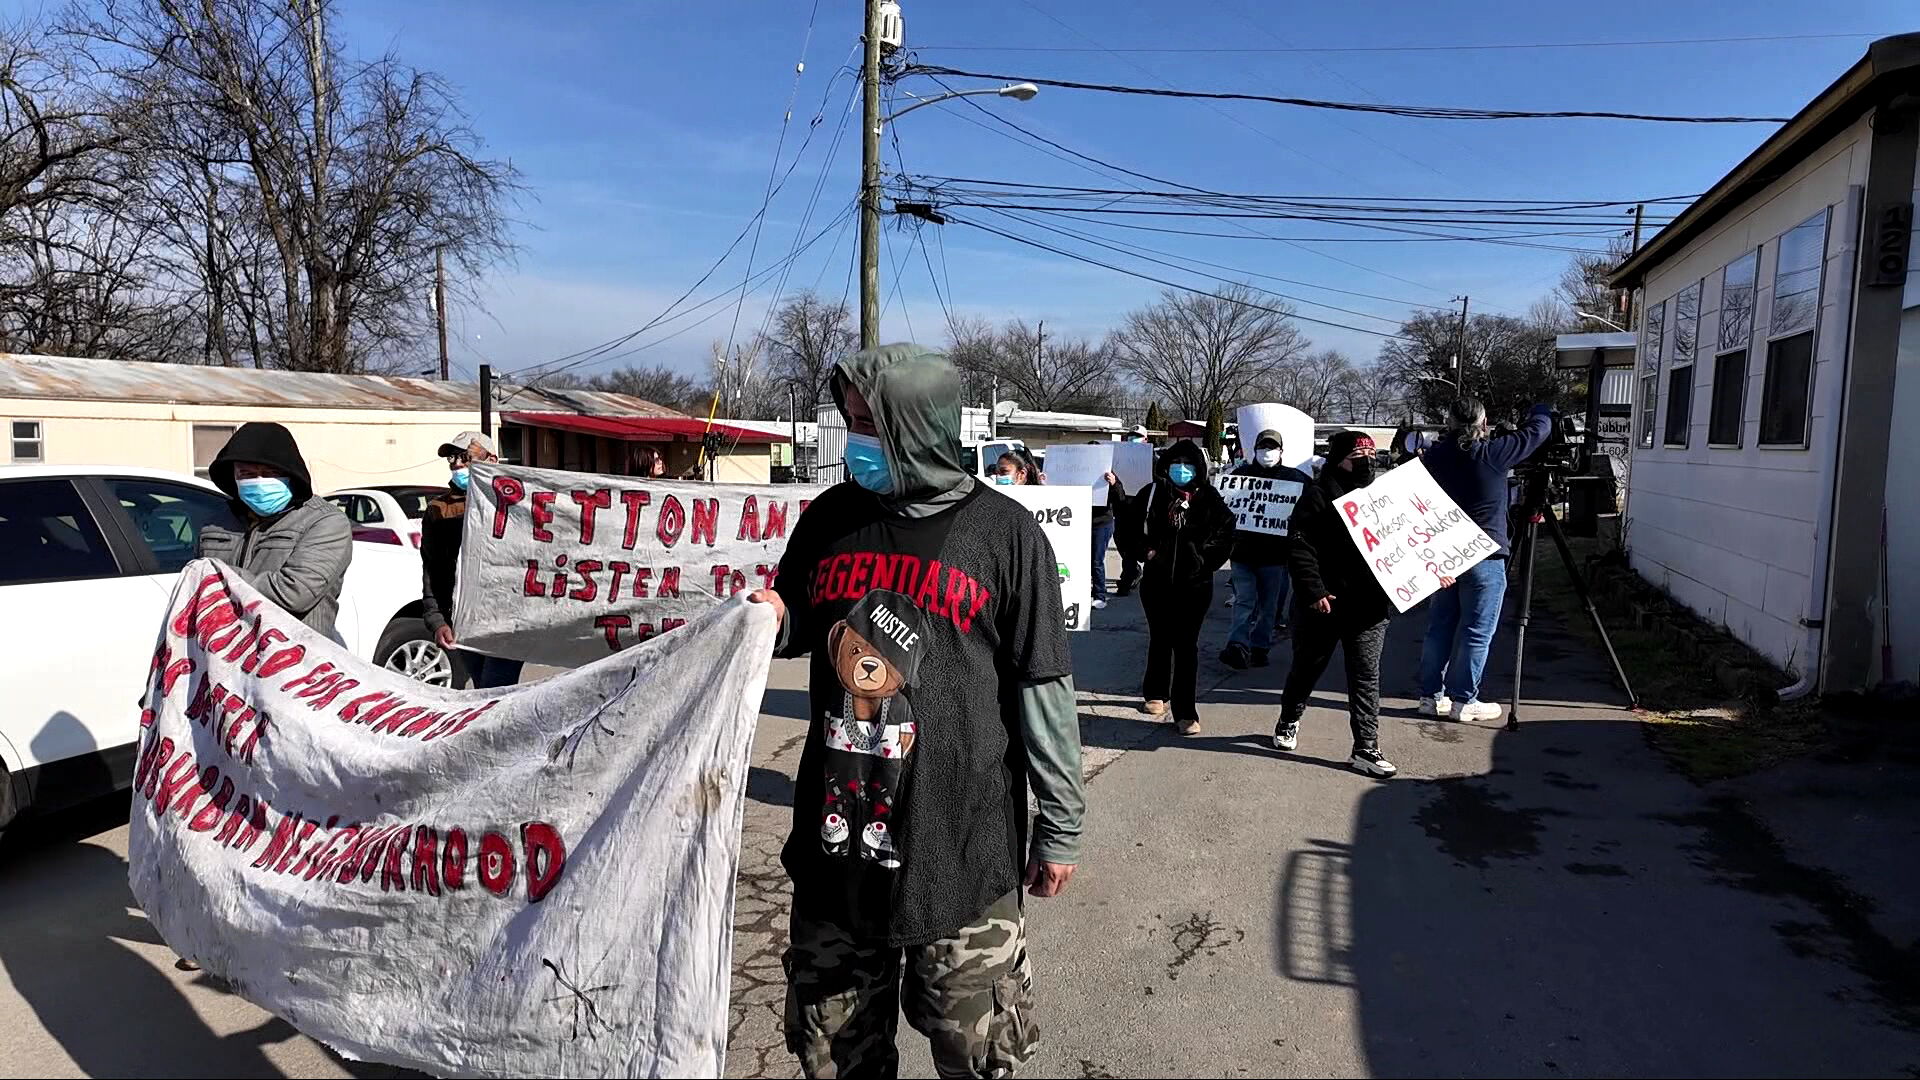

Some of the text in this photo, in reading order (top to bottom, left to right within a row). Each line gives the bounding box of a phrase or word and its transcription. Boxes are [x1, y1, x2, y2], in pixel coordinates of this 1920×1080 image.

[1220, 476, 1273, 491] PEYTON
[1249, 491, 1297, 505] ANDERSON
[1409, 493, 1438, 516] We
[492, 475, 812, 549] PEYTON AN
[1376, 543, 1406, 575] need
[1413, 507, 1471, 544] Solution
[1415, 547, 1435, 562] to
[1396, 534, 1493, 602] our Problems
[869, 603, 921, 652] HUSTLE
[279, 662, 360, 711] FOR
